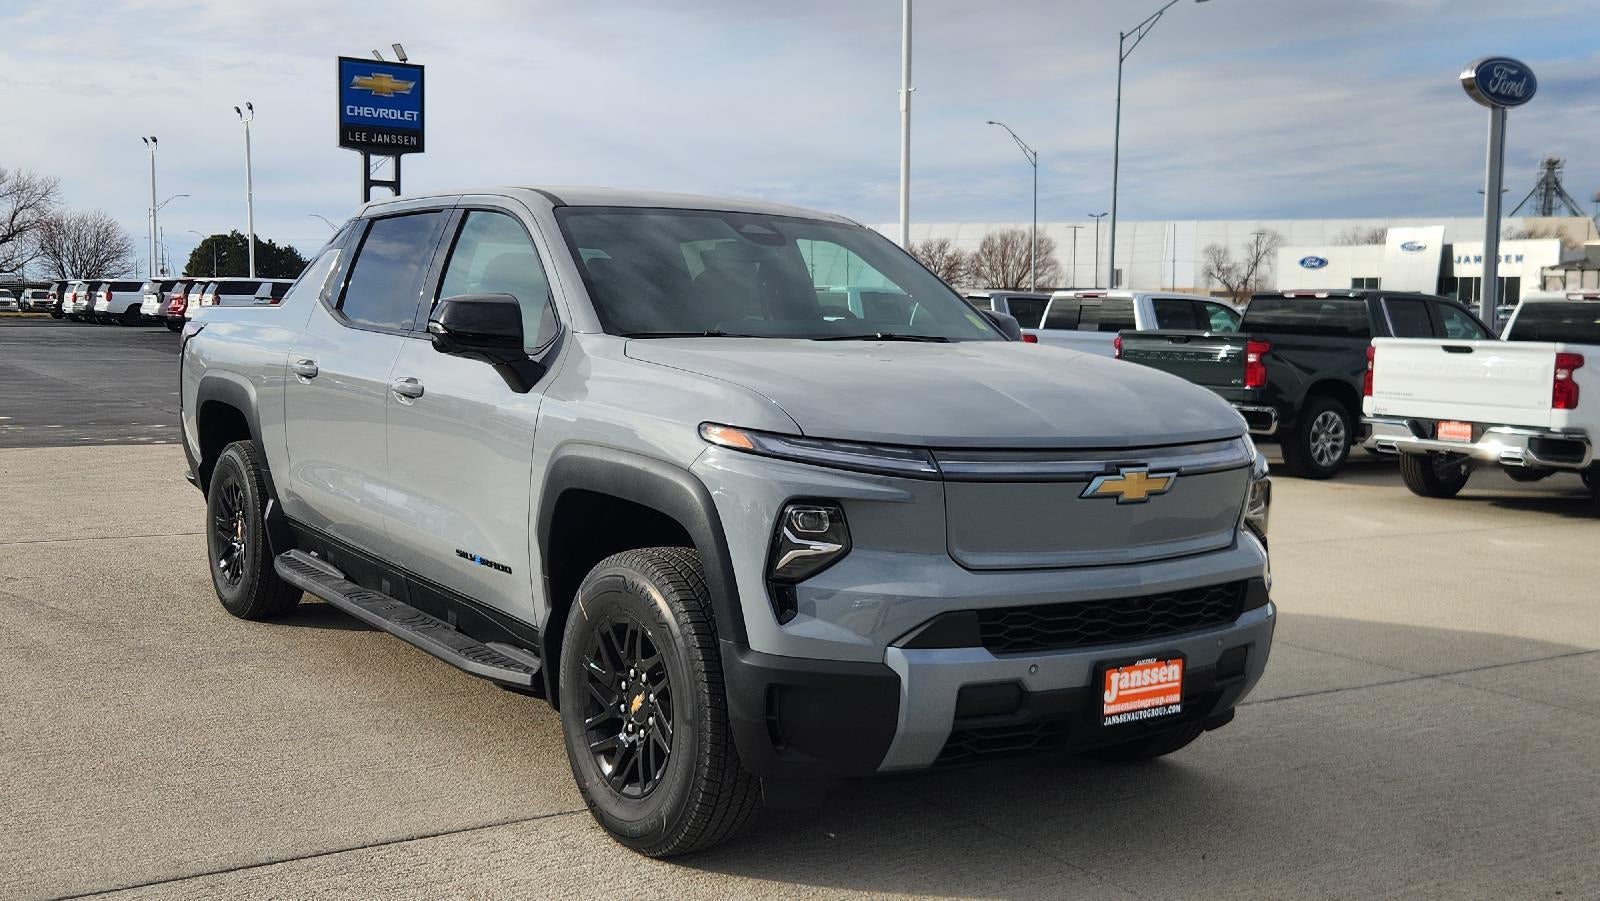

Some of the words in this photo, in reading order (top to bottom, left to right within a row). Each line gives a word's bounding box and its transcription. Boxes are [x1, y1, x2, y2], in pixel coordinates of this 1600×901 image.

[1489, 65, 1526, 96] Ford
[346, 104, 419, 121] CHEVROLET
[348, 131, 367, 142] LEE
[371, 133, 417, 146] JANSSEN
[1454, 254, 1524, 264] JANEN
[455, 548, 513, 575] SILVERADO
[1104, 664, 1180, 703] Janssen
[1103, 704, 1181, 726] JANSSENAUTOGROUP.COM
